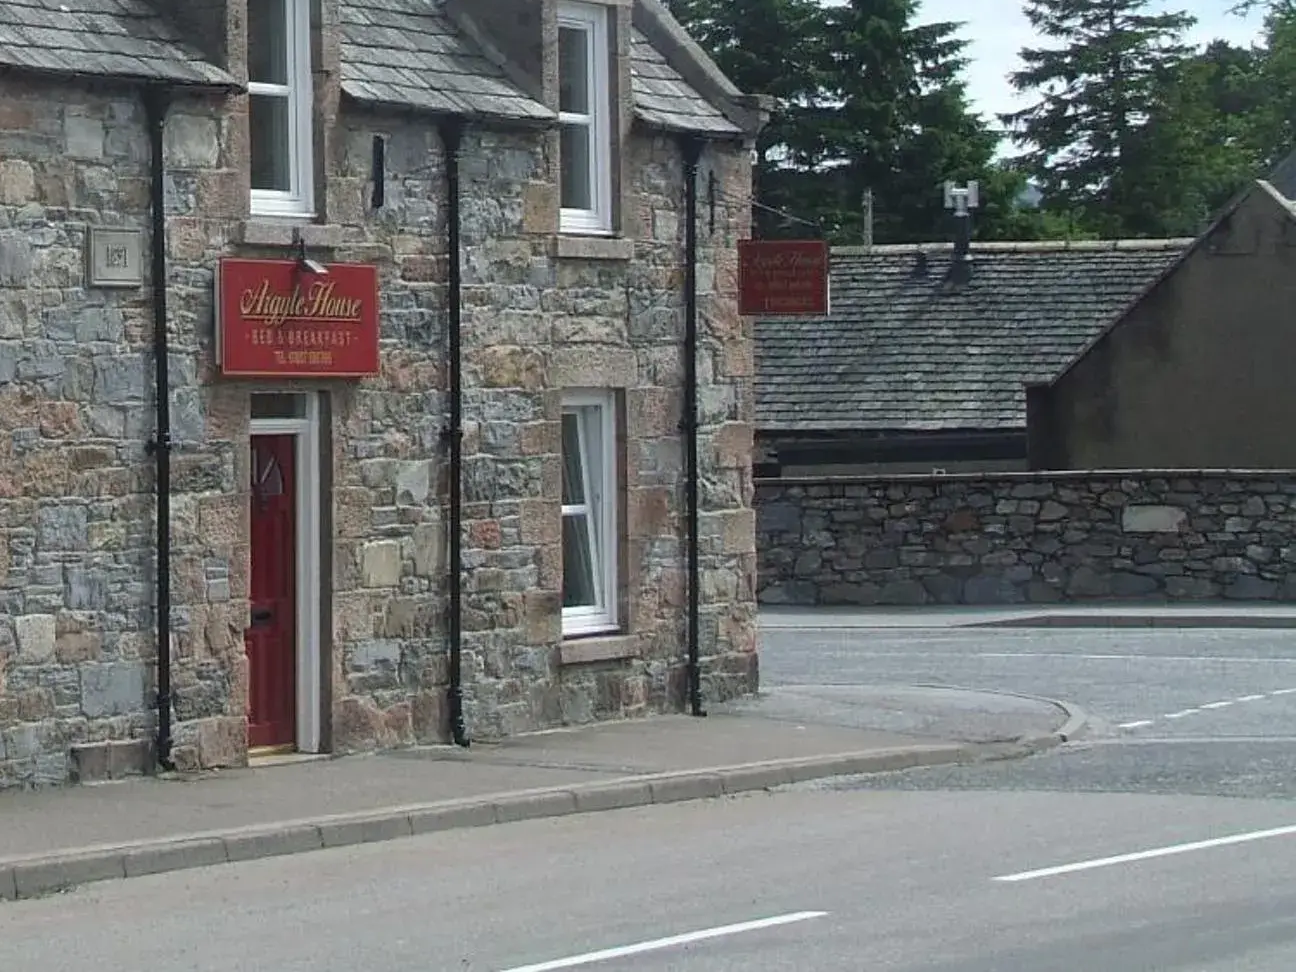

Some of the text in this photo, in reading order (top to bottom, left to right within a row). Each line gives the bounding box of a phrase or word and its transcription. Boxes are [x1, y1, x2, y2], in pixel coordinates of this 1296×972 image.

[240, 280, 362, 324] Argyle House
[252, 329, 273, 344] BED
[288, 329, 351, 346] BREAKFAST
